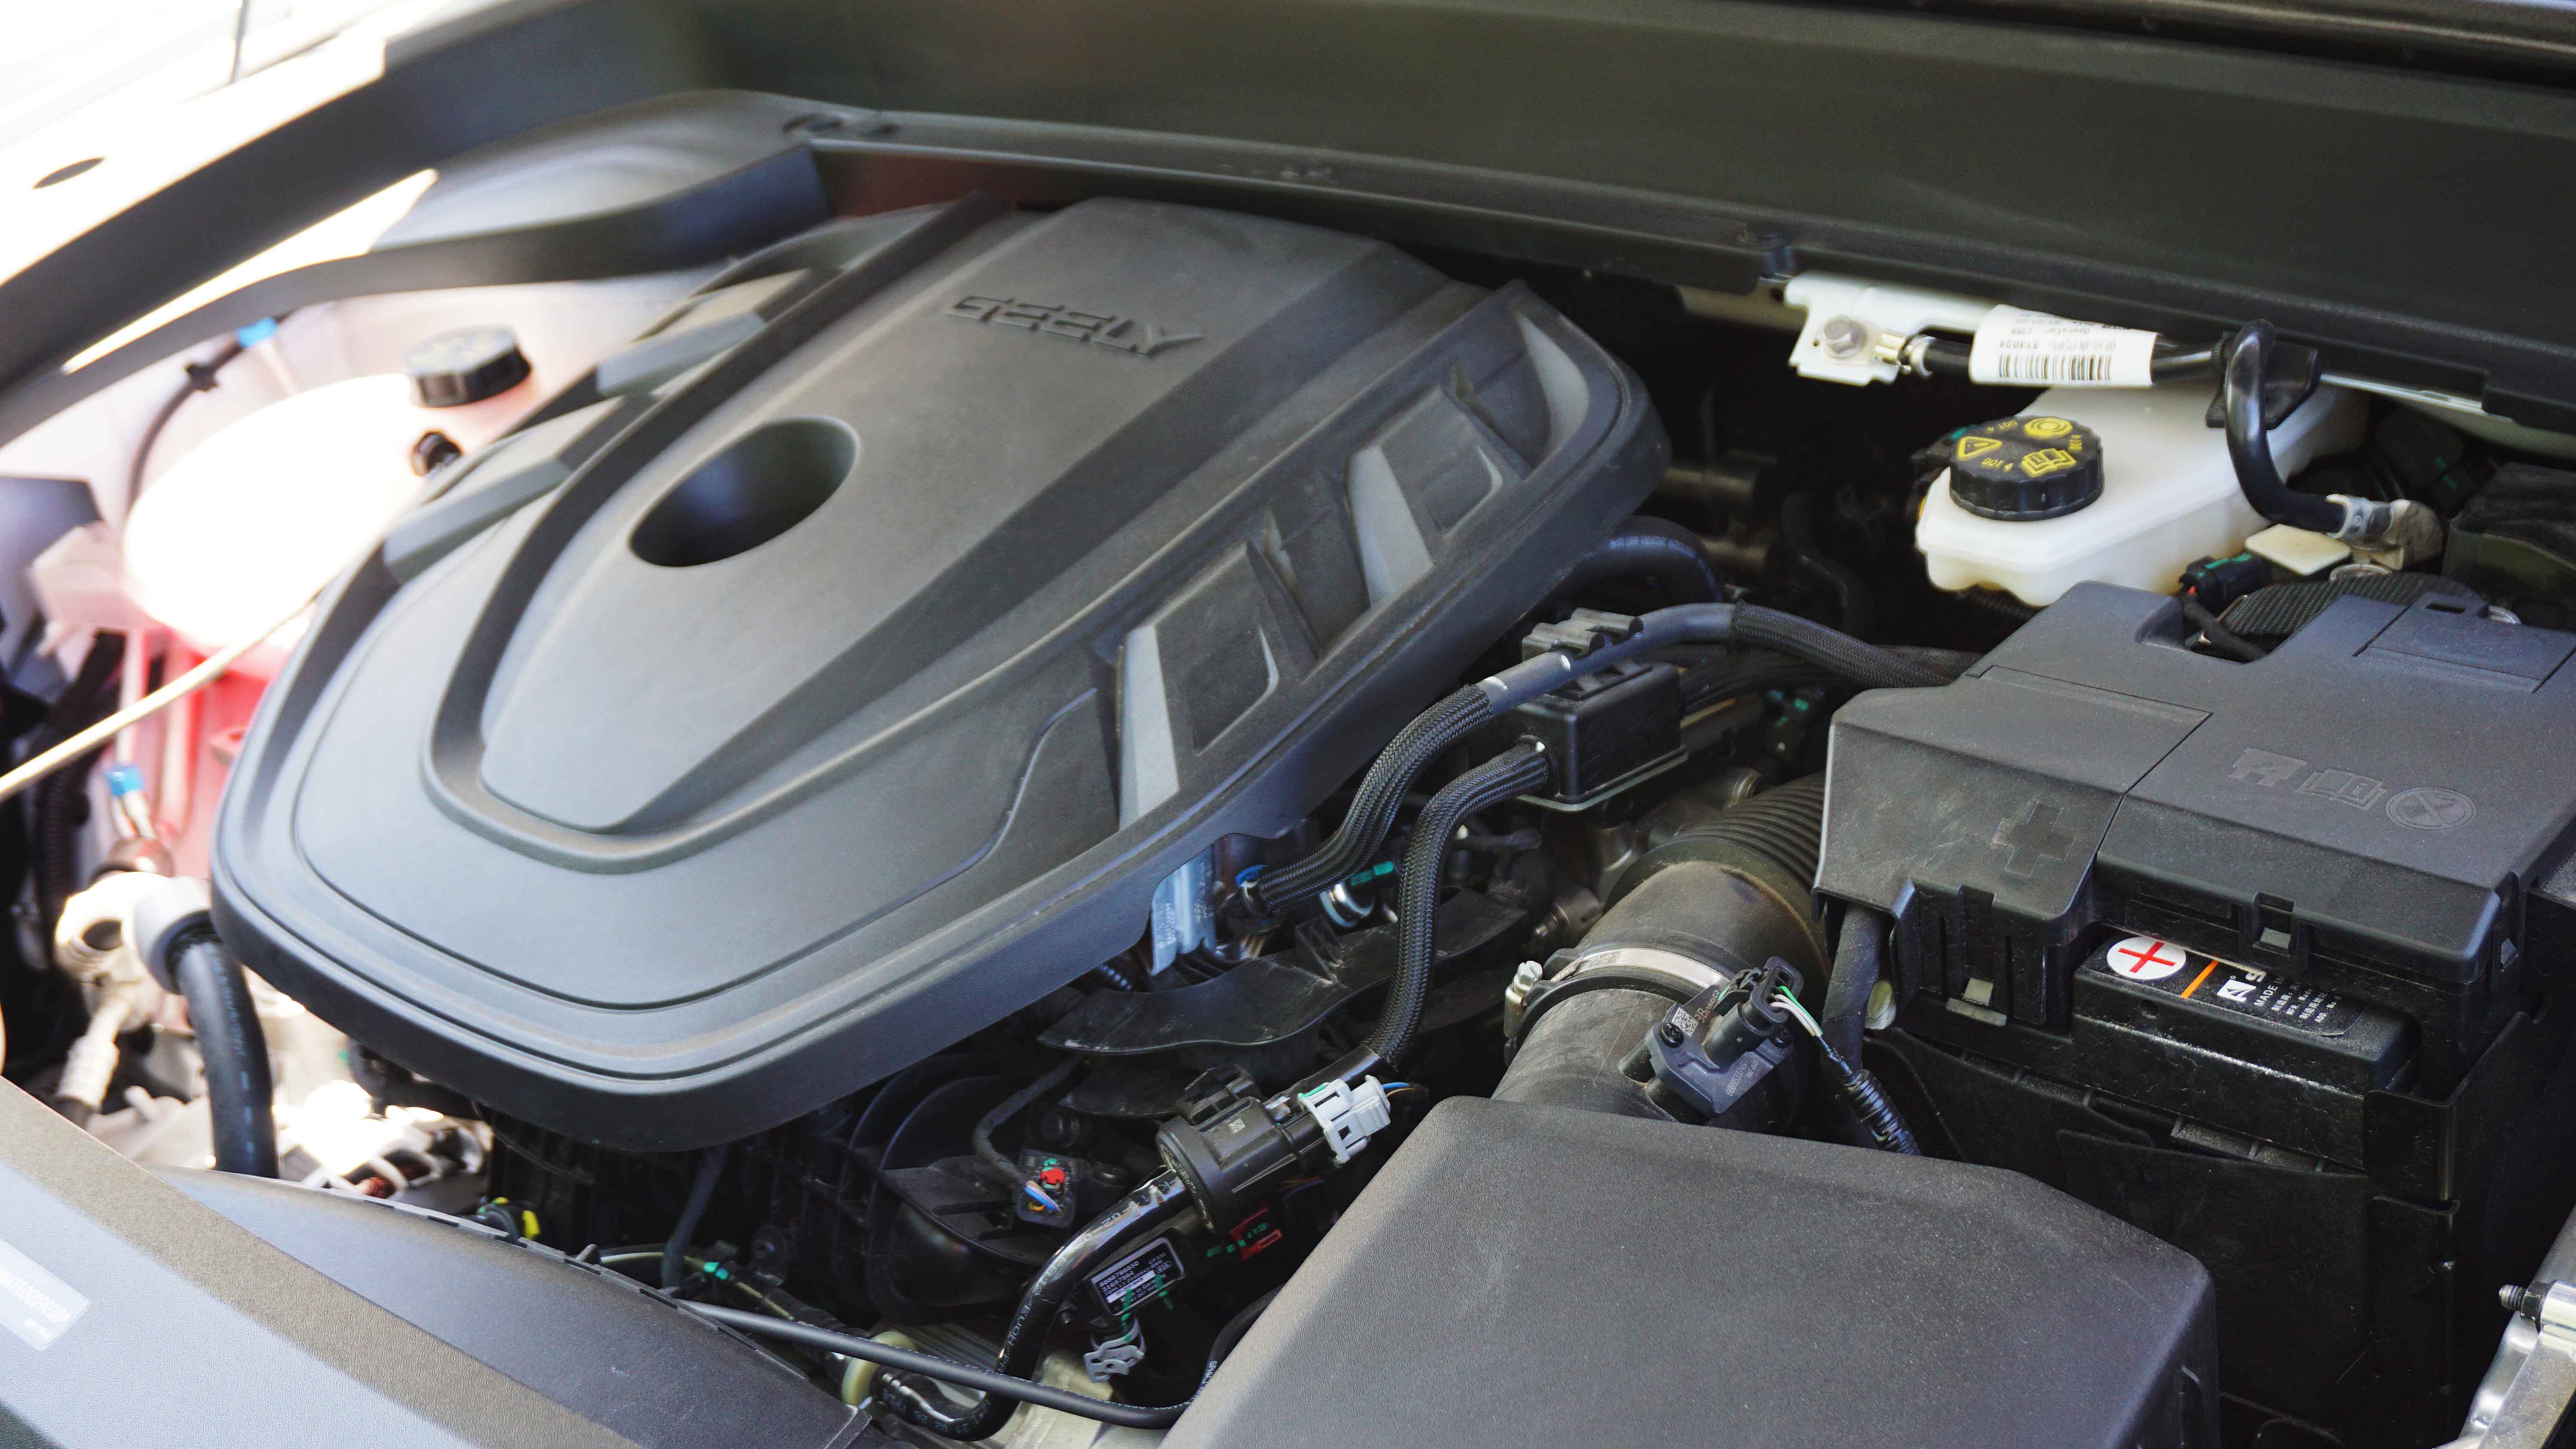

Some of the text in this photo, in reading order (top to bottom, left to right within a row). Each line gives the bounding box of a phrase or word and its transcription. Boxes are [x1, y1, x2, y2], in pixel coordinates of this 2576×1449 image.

[1998, 420, 2018, 430] DOT
[1981, 458, 2013, 471] DOT 4
[2254, 984, 2278, 1007] MADE
